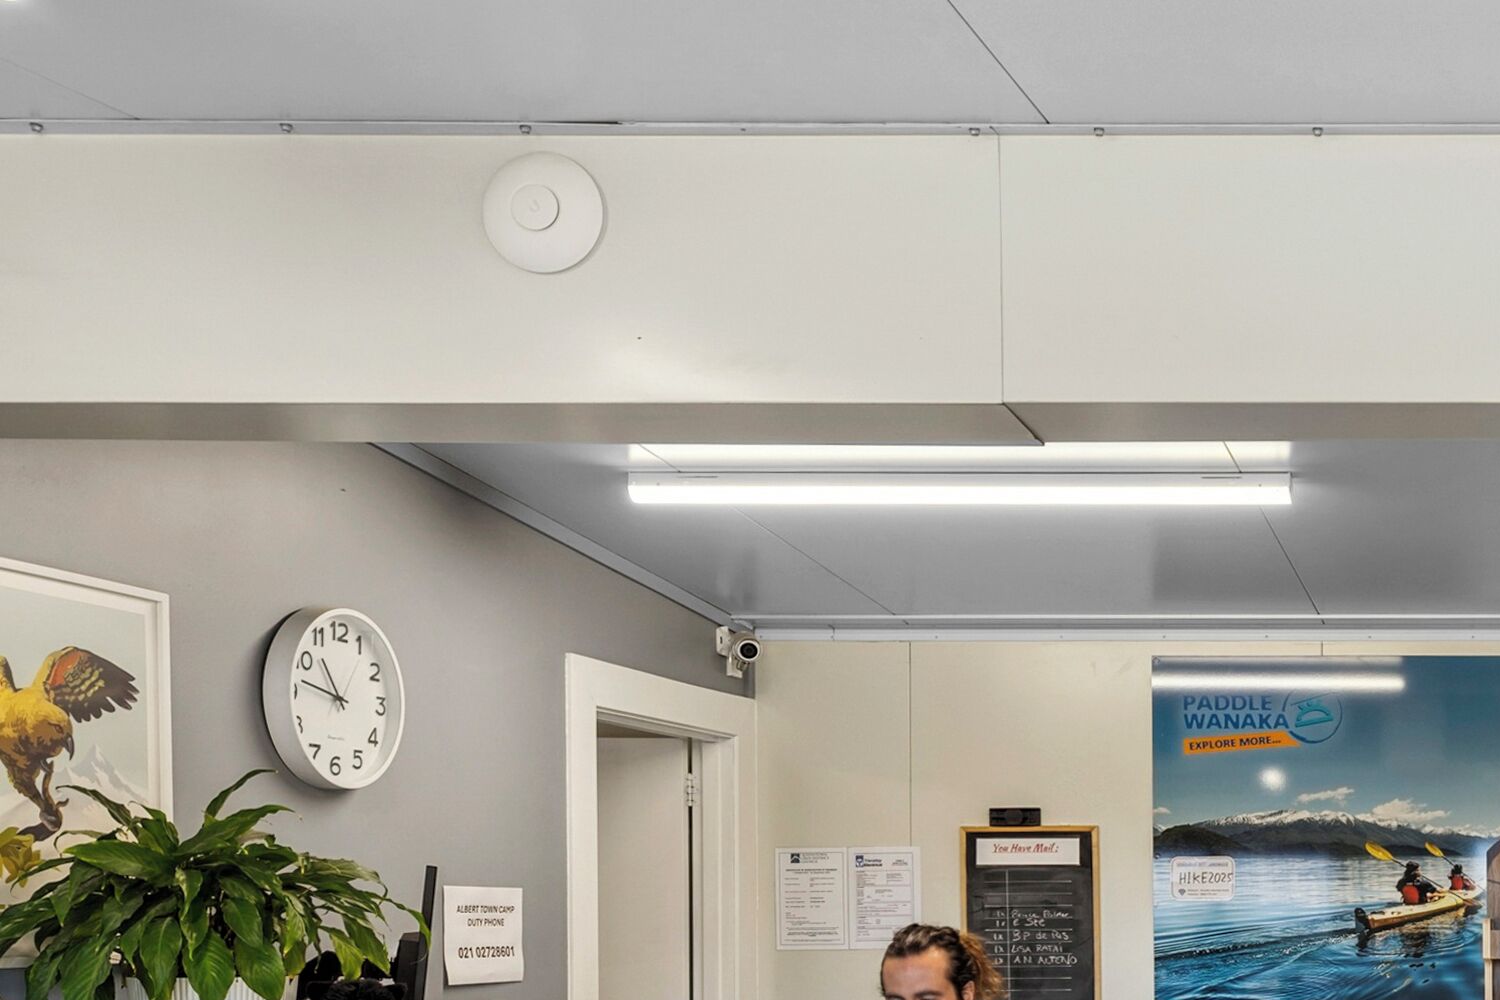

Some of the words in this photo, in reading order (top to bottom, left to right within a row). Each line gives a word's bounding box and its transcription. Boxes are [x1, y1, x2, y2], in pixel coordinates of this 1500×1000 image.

[311, 627, 324, 647] 11
[330, 621, 348, 643] 12
[356, 635, 362, 655] 1
[369, 663, 380, 682] 2
[375, 696, 386, 716] 3
[1183, 695, 1272, 711] PADDLE
[1184, 713, 1289, 729] WANAKA
[368, 727, 378, 747] 4
[1189, 738, 1236, 750] EXPLORE
[309, 743, 321, 760] 7
[352, 750, 363, 769] 5
[329, 756, 341, 775] 6
[992, 843, 1008, 853] You
[1010, 843, 1032, 852] Have
[1033, 842, 1059, 853] Mail:
[457, 905, 479, 914] ALBERT
[480, 905, 498, 914] TOWN
[499, 905, 515, 914] CAMP
[467, 918, 483, 927] DUTY
[484, 918, 505, 927] PHONE
[458, 947, 474, 959] 021
[475, 946, 515, 958] 02728601
